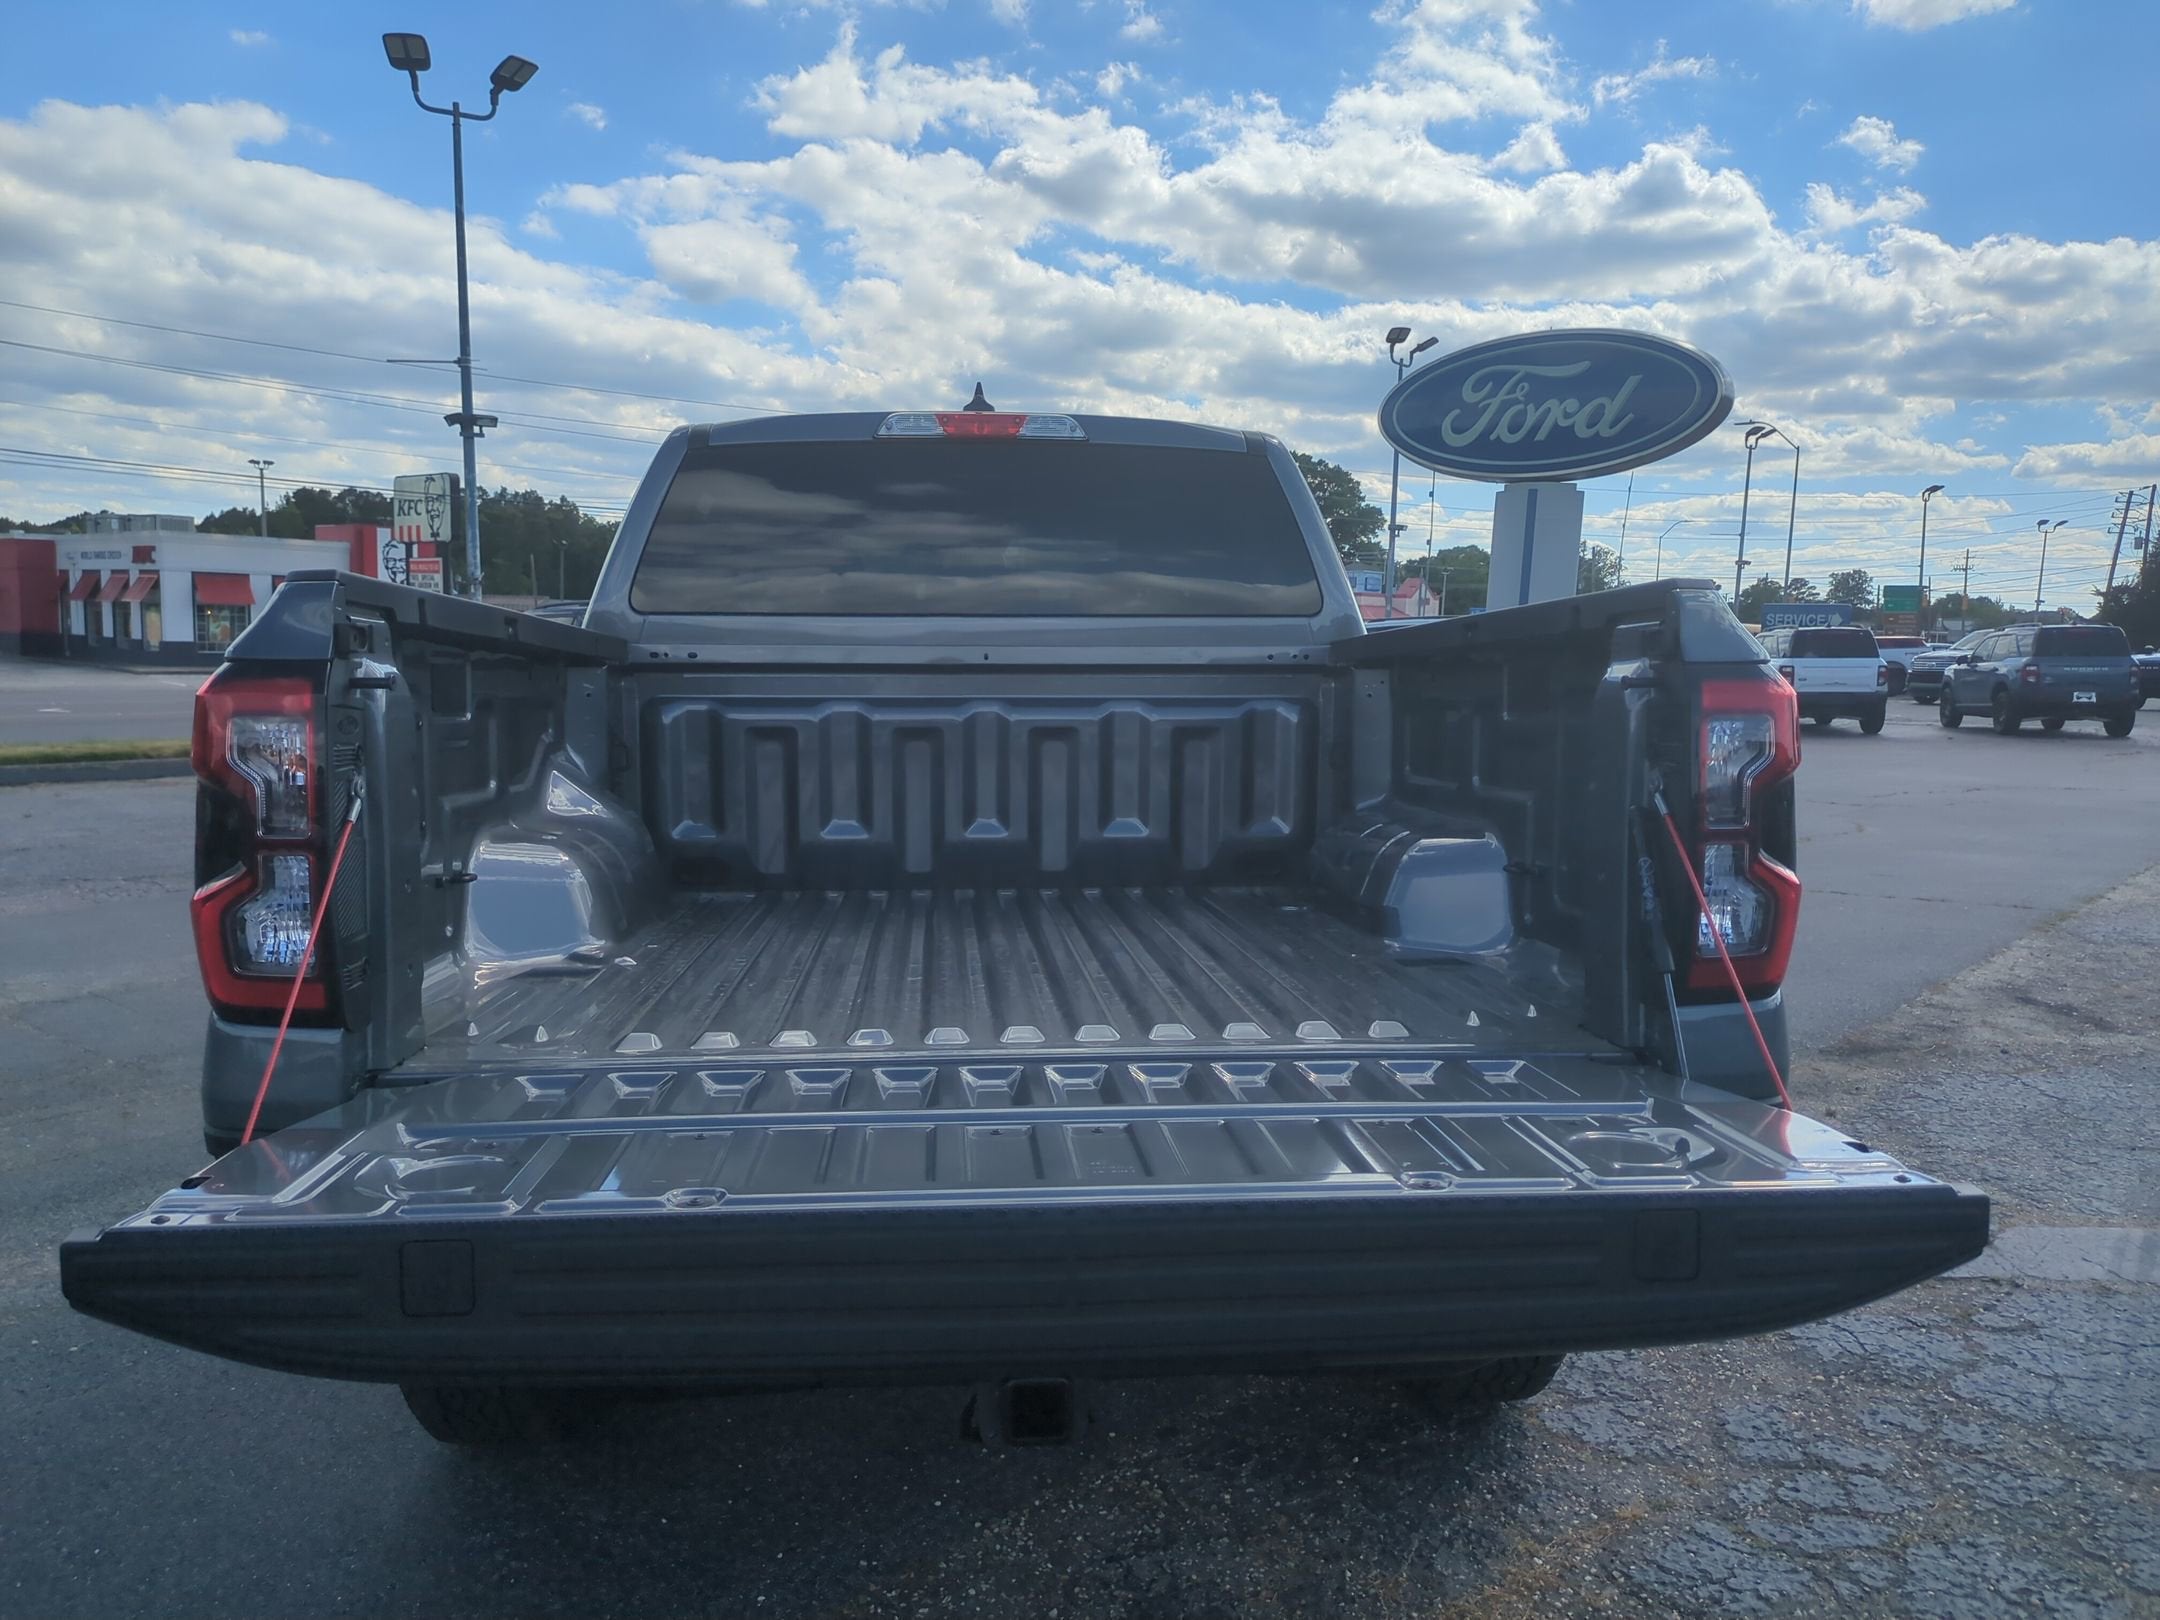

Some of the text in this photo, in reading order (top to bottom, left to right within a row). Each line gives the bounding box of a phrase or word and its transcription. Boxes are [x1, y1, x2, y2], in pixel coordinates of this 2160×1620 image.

[1441, 360, 1643, 447] Ford
[397, 499, 423, 517] KFC
[1766, 613, 1826, 626] SERVICE
